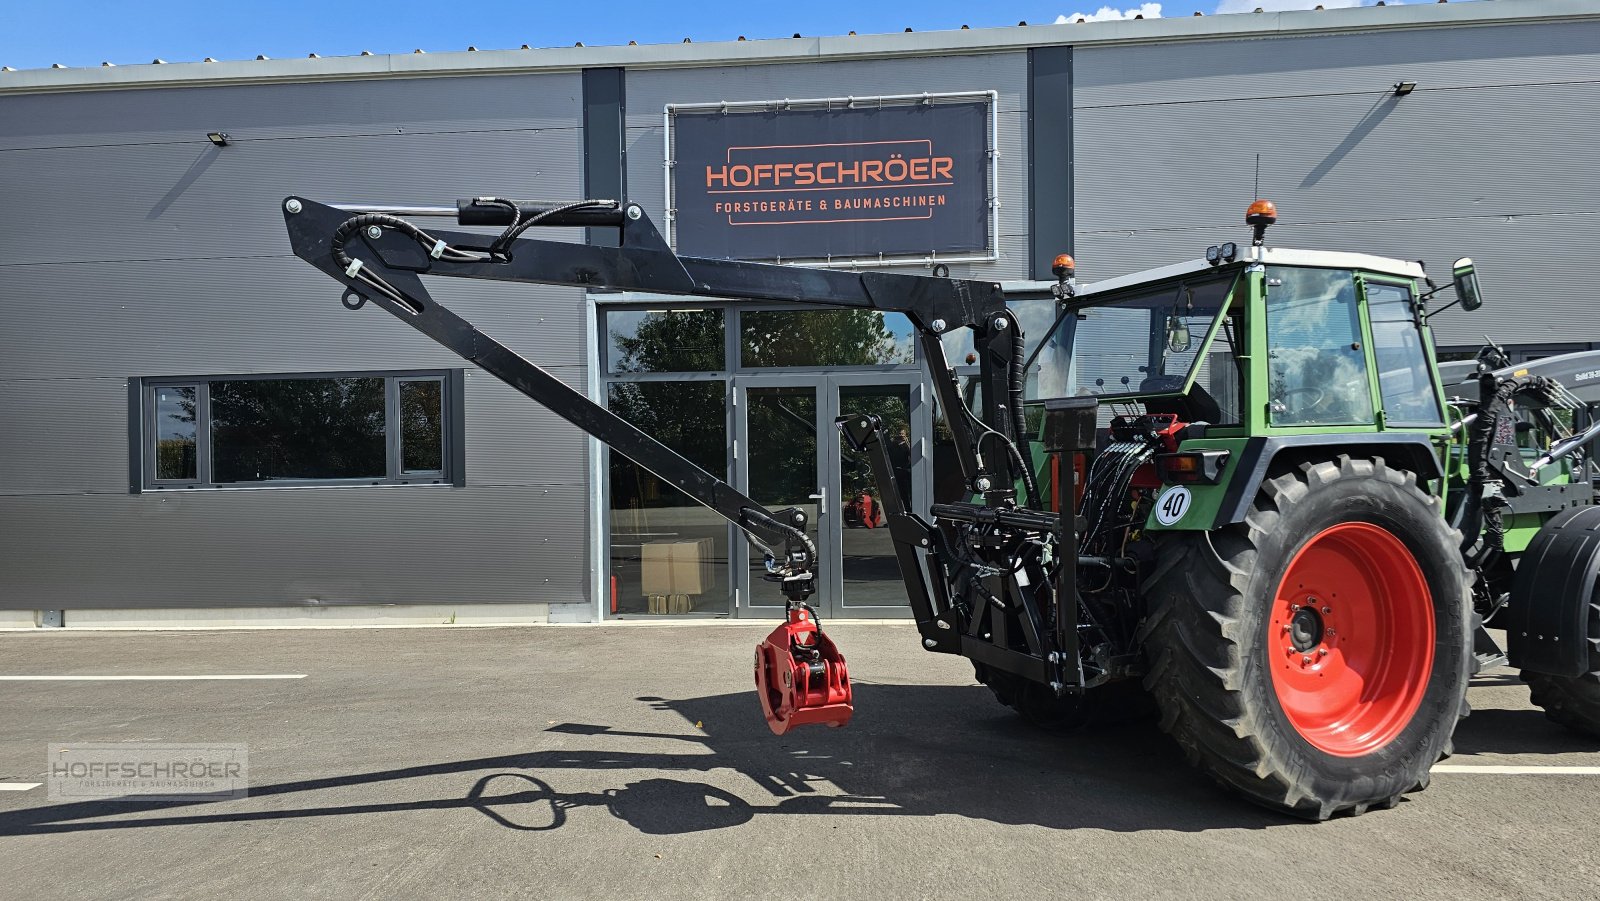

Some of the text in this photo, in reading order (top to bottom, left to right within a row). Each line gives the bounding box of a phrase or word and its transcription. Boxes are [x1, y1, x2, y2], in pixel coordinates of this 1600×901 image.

[706, 153, 954, 188] HOFFSCHRÖER
[715, 194, 946, 213] FORSTGERÄTE & BAUMASCHINEN
[1162, 492, 1185, 517] 40
